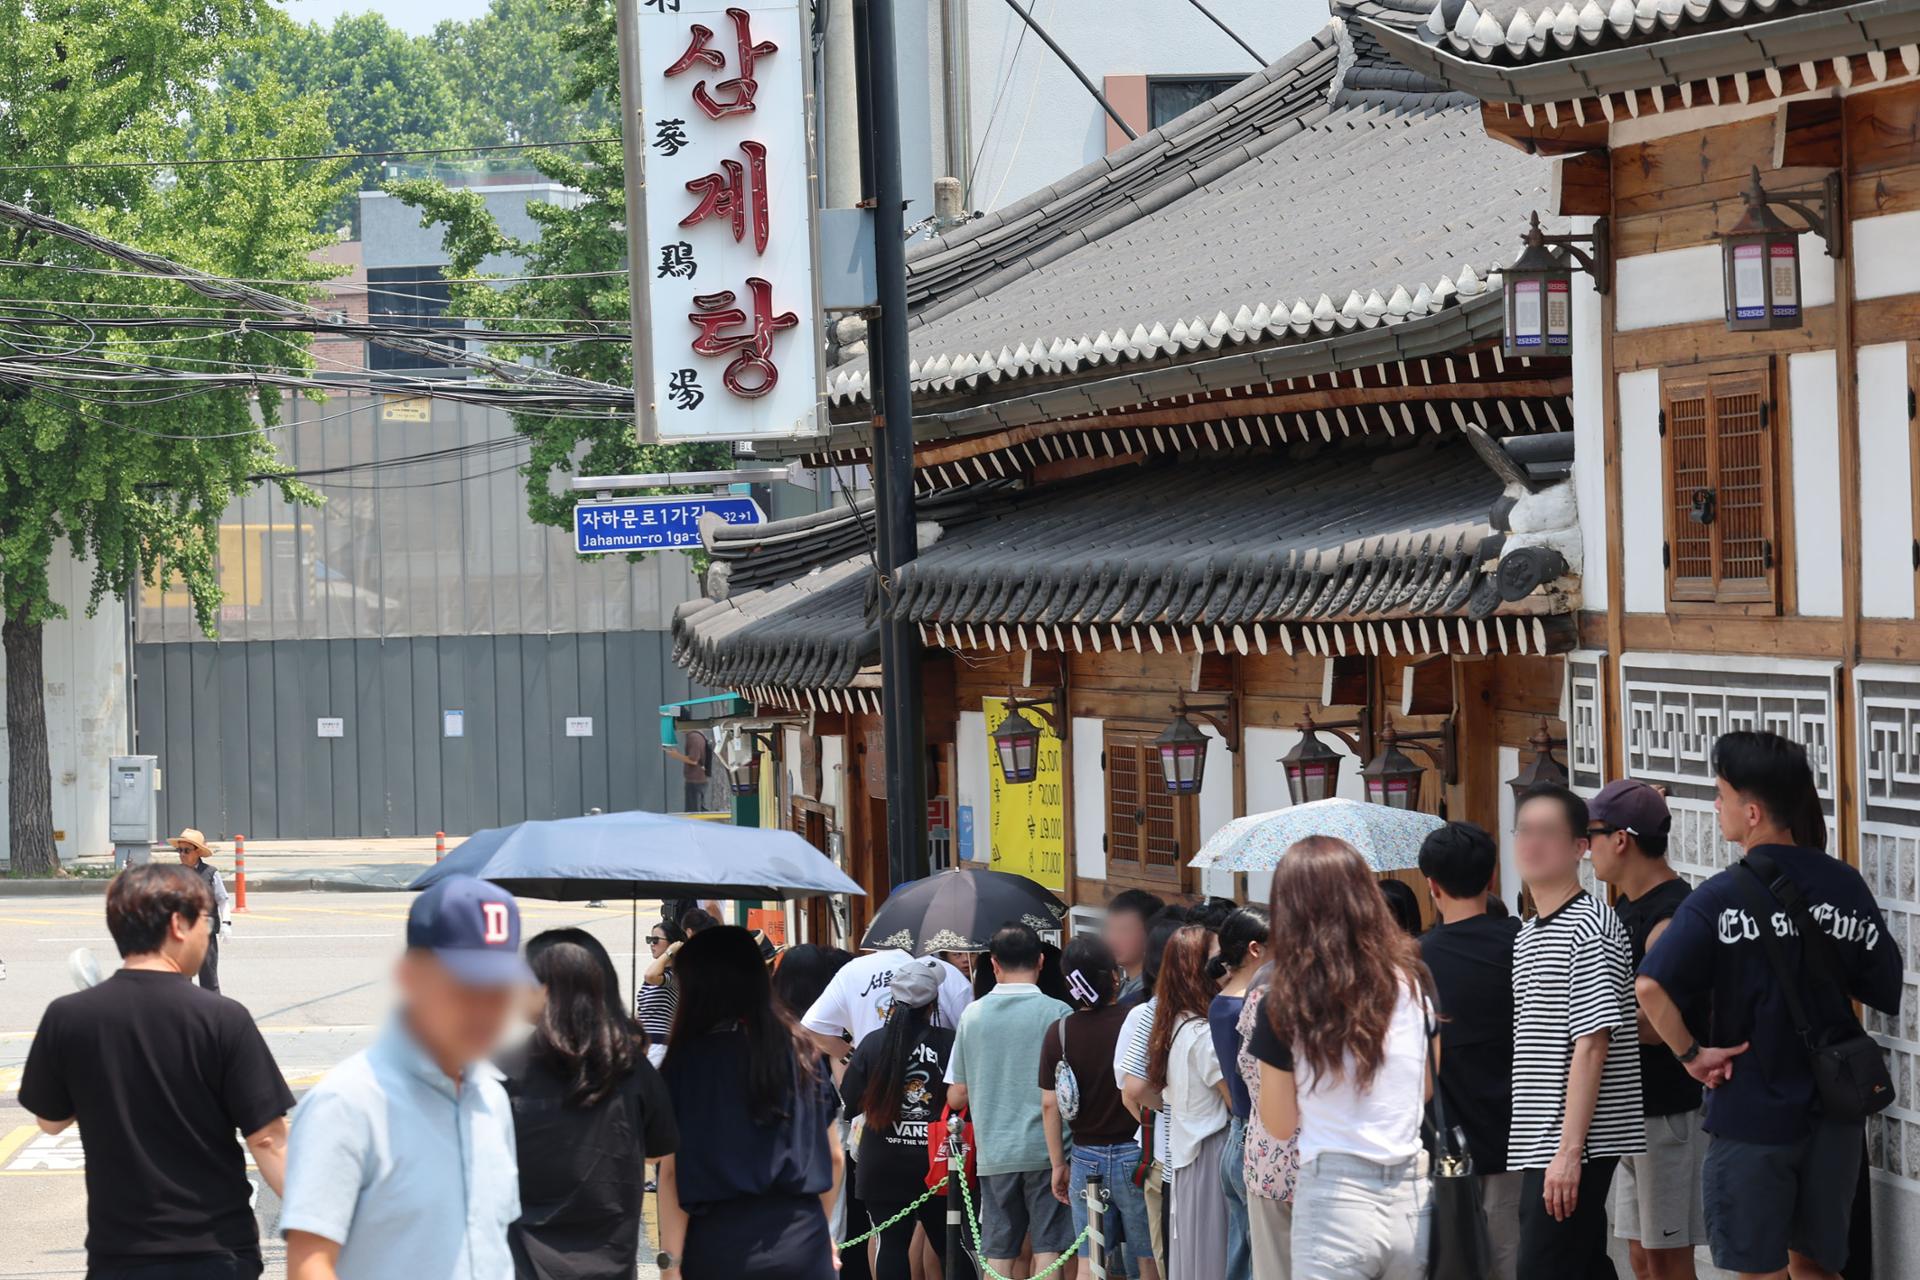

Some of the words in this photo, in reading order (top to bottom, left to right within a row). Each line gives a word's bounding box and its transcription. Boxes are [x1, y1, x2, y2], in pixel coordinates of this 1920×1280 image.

[664, 7, 799, 399] 삼계탕
[583, 533, 663, 547] Jahamun-ro
[480, 901, 509, 944] D
[902, 1138, 917, 1146] THE
